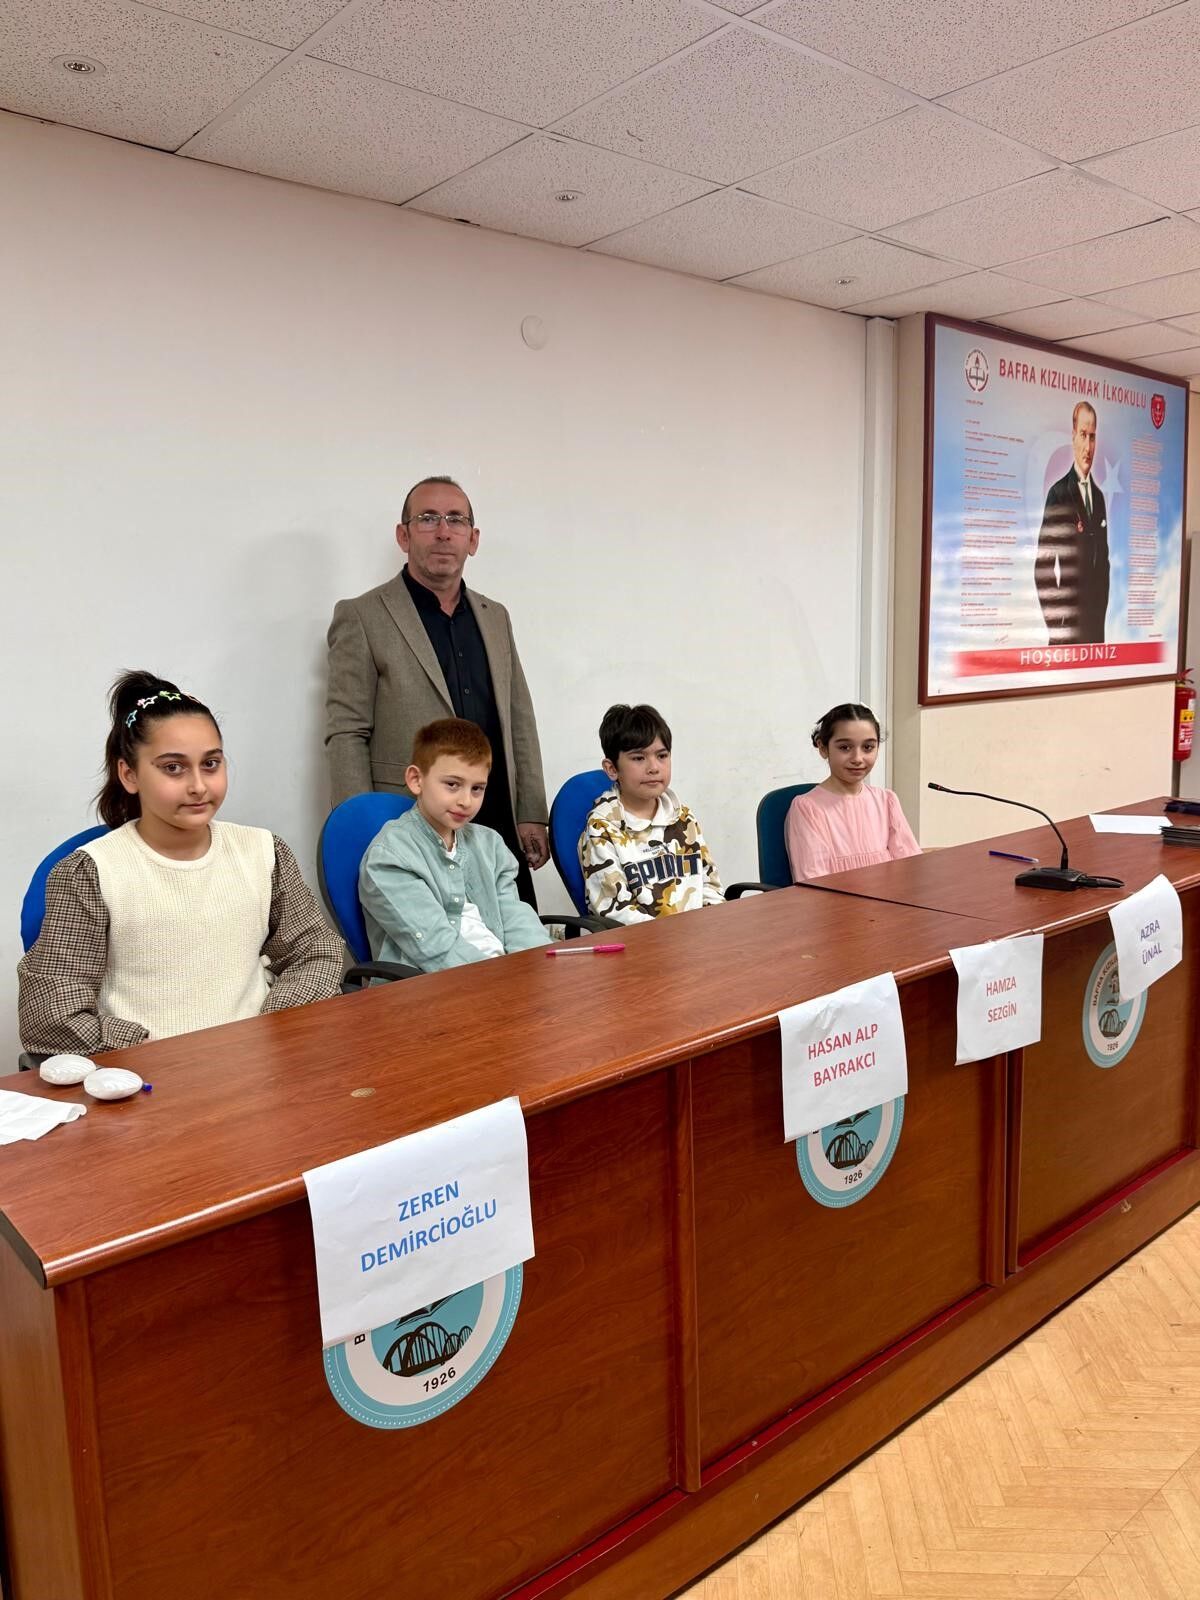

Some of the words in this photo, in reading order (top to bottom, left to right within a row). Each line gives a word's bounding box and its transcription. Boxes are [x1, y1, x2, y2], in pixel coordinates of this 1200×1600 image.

[999, 358, 1036, 385] BAFRA
[1040, 367, 1100, 399] KIZILIRMAK
[1102, 379, 1147, 409] İLKOKULU
[1020, 643, 1117, 667] HOŞGELDİNİZ
[1140, 919, 1161, 941] AZRA
[1142, 943, 1163, 965] ÜNAL
[986, 976, 1017, 997] HAMZA
[988, 1002, 1017, 1023] SEZGİN
[808, 1031, 852, 1060] HASAN
[855, 1023, 878, 1044] ALP
[813, 1052, 876, 1087] BAYRAKCI
[844, 1170, 863, 1185] 1926
[398, 1180, 460, 1222] ZEREN
[361, 1199, 498, 1272] DEMİRCİOĞLU
[422, 1366, 456, 1393] 1926
